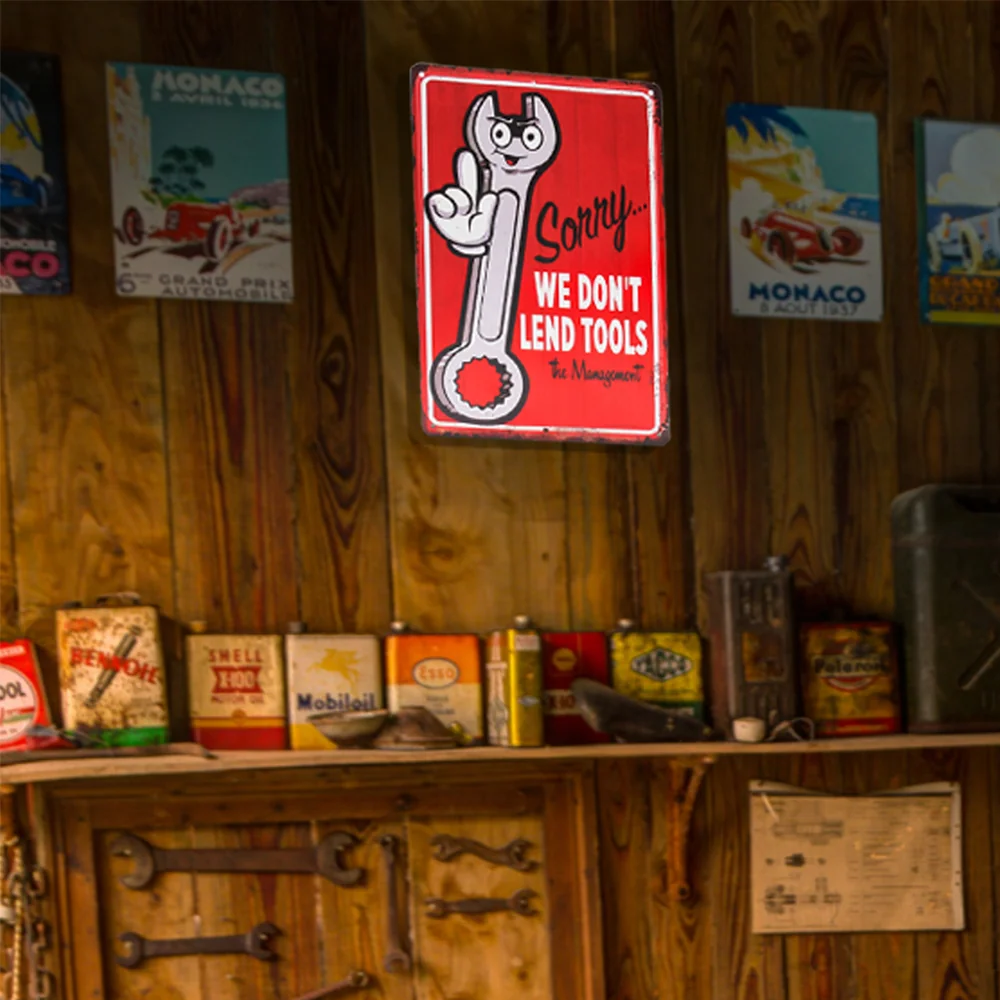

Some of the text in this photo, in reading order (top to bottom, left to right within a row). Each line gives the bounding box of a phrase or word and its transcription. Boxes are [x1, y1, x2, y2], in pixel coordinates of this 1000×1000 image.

[151, 70, 285, 98] MONACO
[0, 248, 60, 280] CO
[158, 274, 229, 287] GRAND
[241, 277, 290, 289] PRIX
[533, 271, 642, 312] WE DON'T
[749, 282, 866, 303] MONACO
[774, 302, 817, 314] AOUT
[520, 314, 649, 356] LEND TOOLS
[548, 359, 644, 389] the Management
[208, 649, 263, 663] SHELL
[297, 692, 377, 711] Mobiloil
